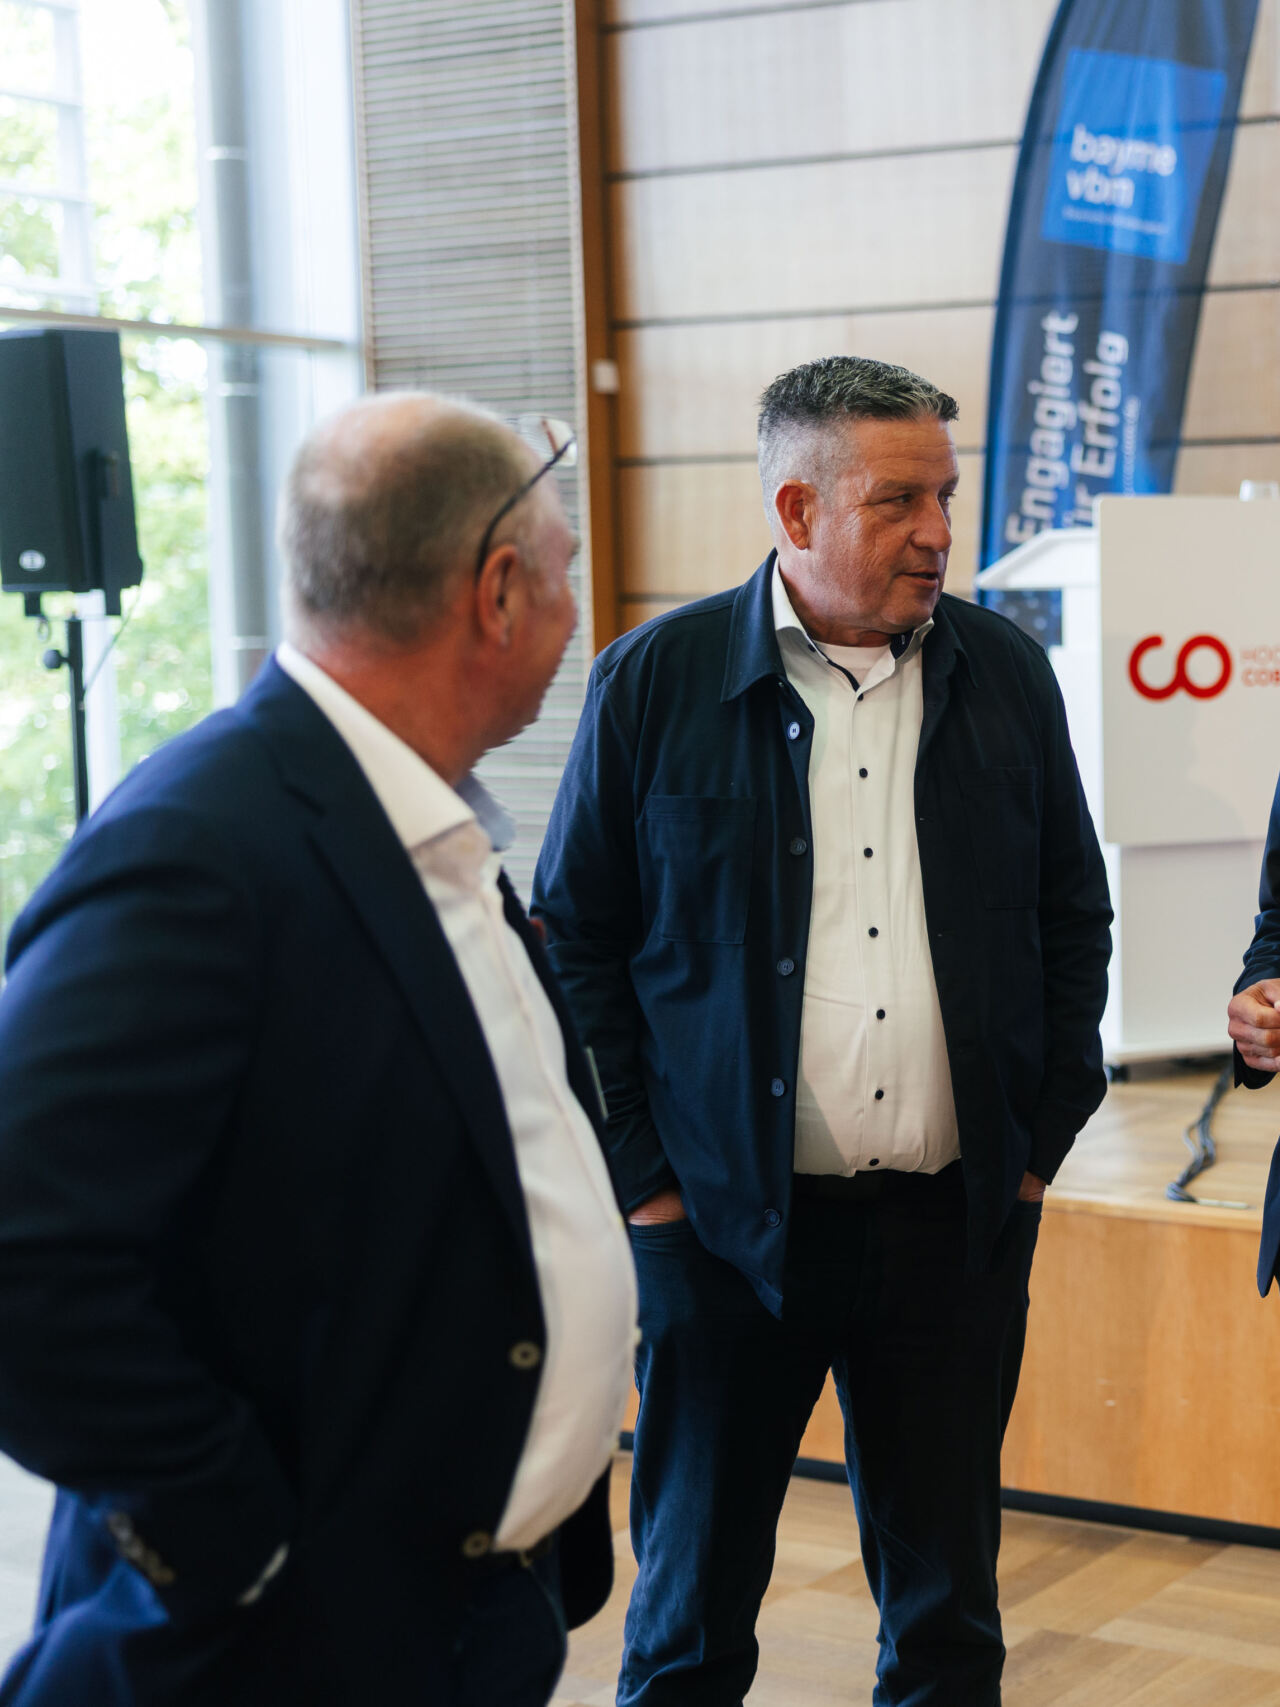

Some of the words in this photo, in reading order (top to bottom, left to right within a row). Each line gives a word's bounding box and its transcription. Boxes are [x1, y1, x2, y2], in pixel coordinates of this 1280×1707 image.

[1066, 165, 1135, 208] vbm
[1071, 123, 1177, 176] bayme
[1005, 310, 1079, 544] Engagiert
[1069, 331, 1129, 480] Erfolg
